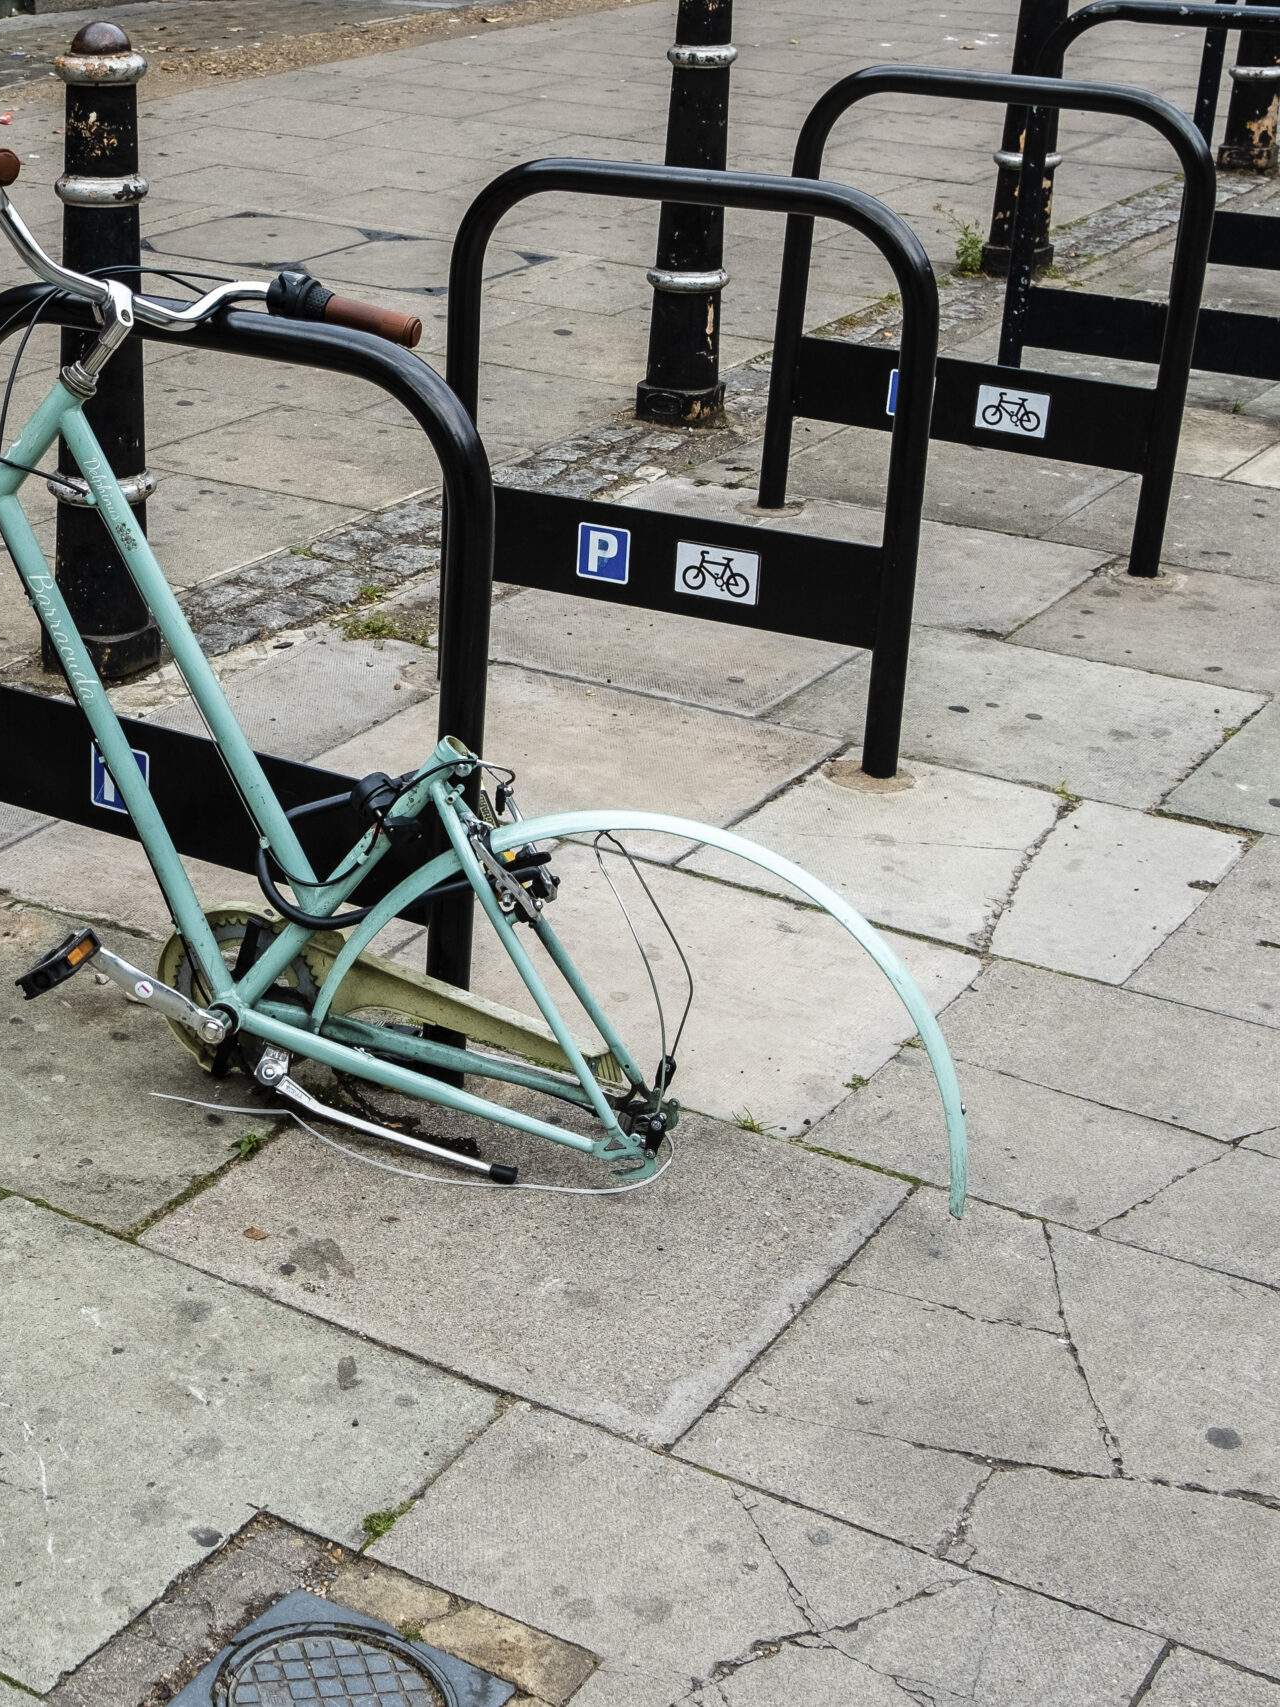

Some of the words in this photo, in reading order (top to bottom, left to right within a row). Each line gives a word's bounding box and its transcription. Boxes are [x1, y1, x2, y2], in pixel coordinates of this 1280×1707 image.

[83, 457, 120, 520] Delphinus
[587, 530, 618, 573] P
[27, 572, 99, 703] Barracuda
